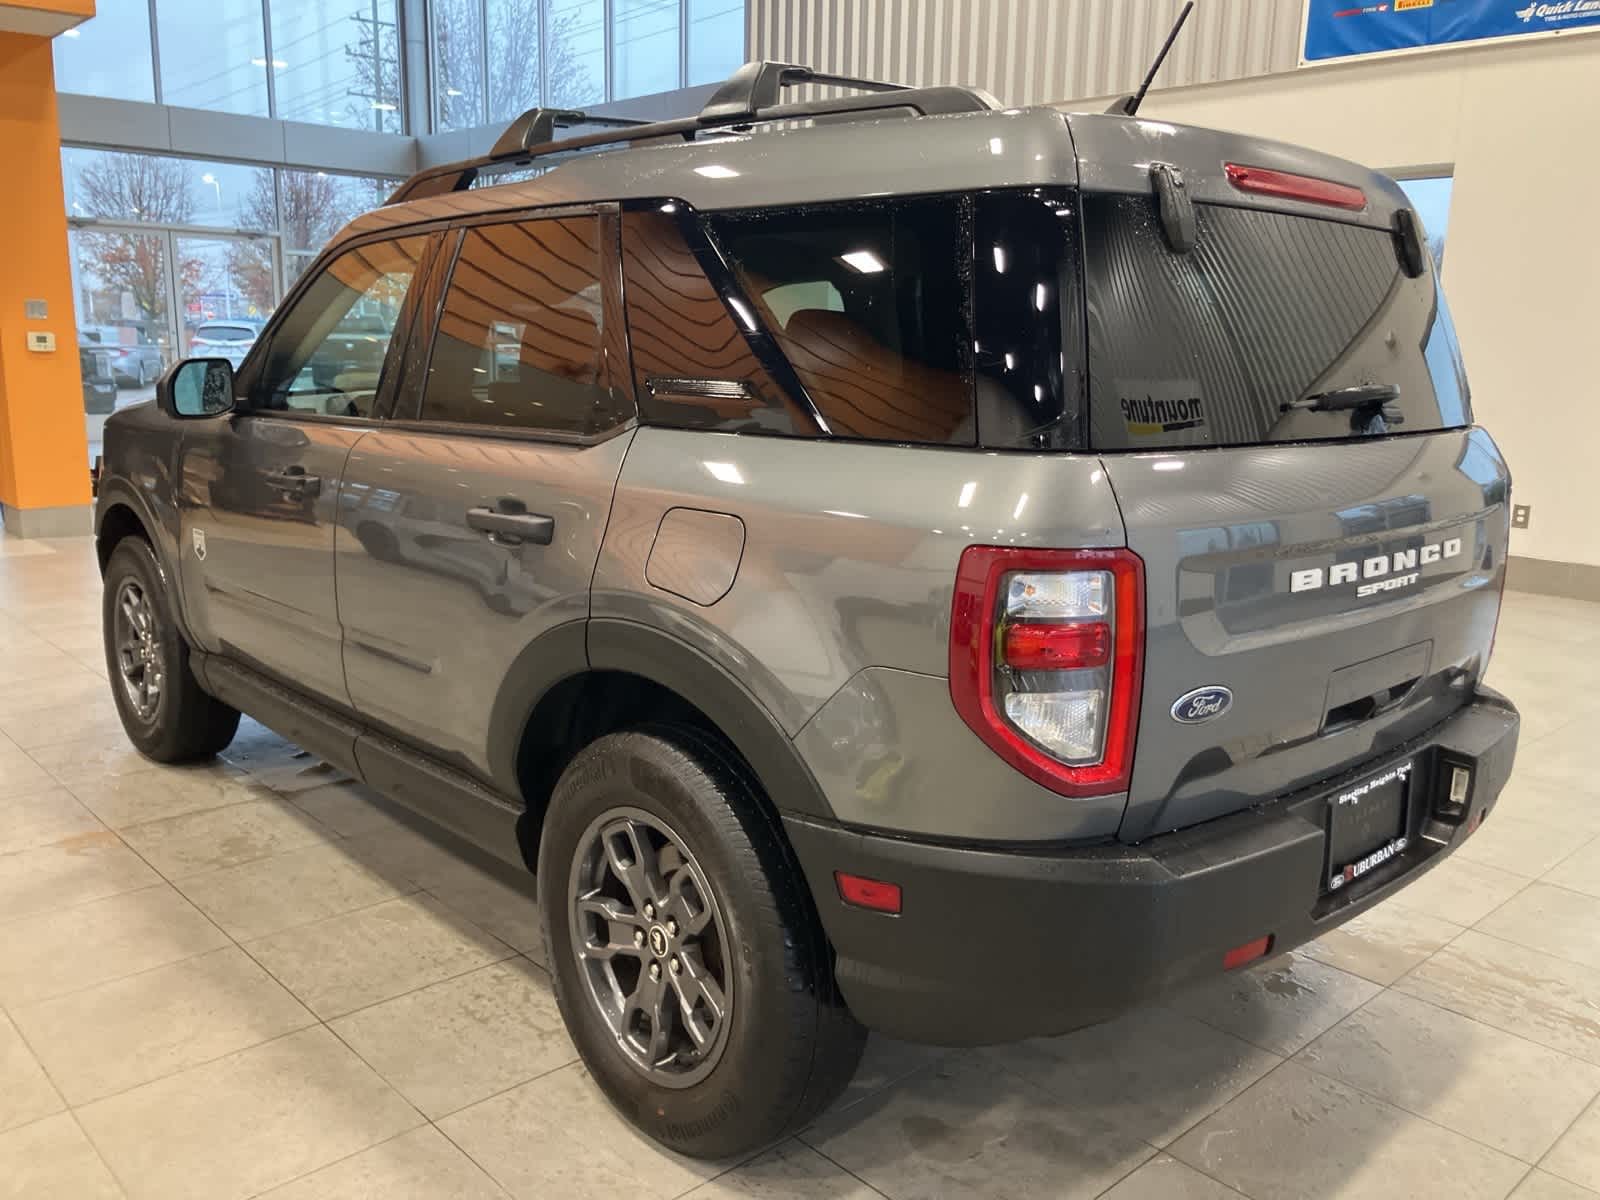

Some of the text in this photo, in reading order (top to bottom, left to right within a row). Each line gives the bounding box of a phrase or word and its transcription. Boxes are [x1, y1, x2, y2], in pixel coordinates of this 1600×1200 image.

[1536, 1, 1574, 17] Quick
[1291, 538, 1461, 592] BRONCO
[1357, 573, 1419, 597] SPORT
